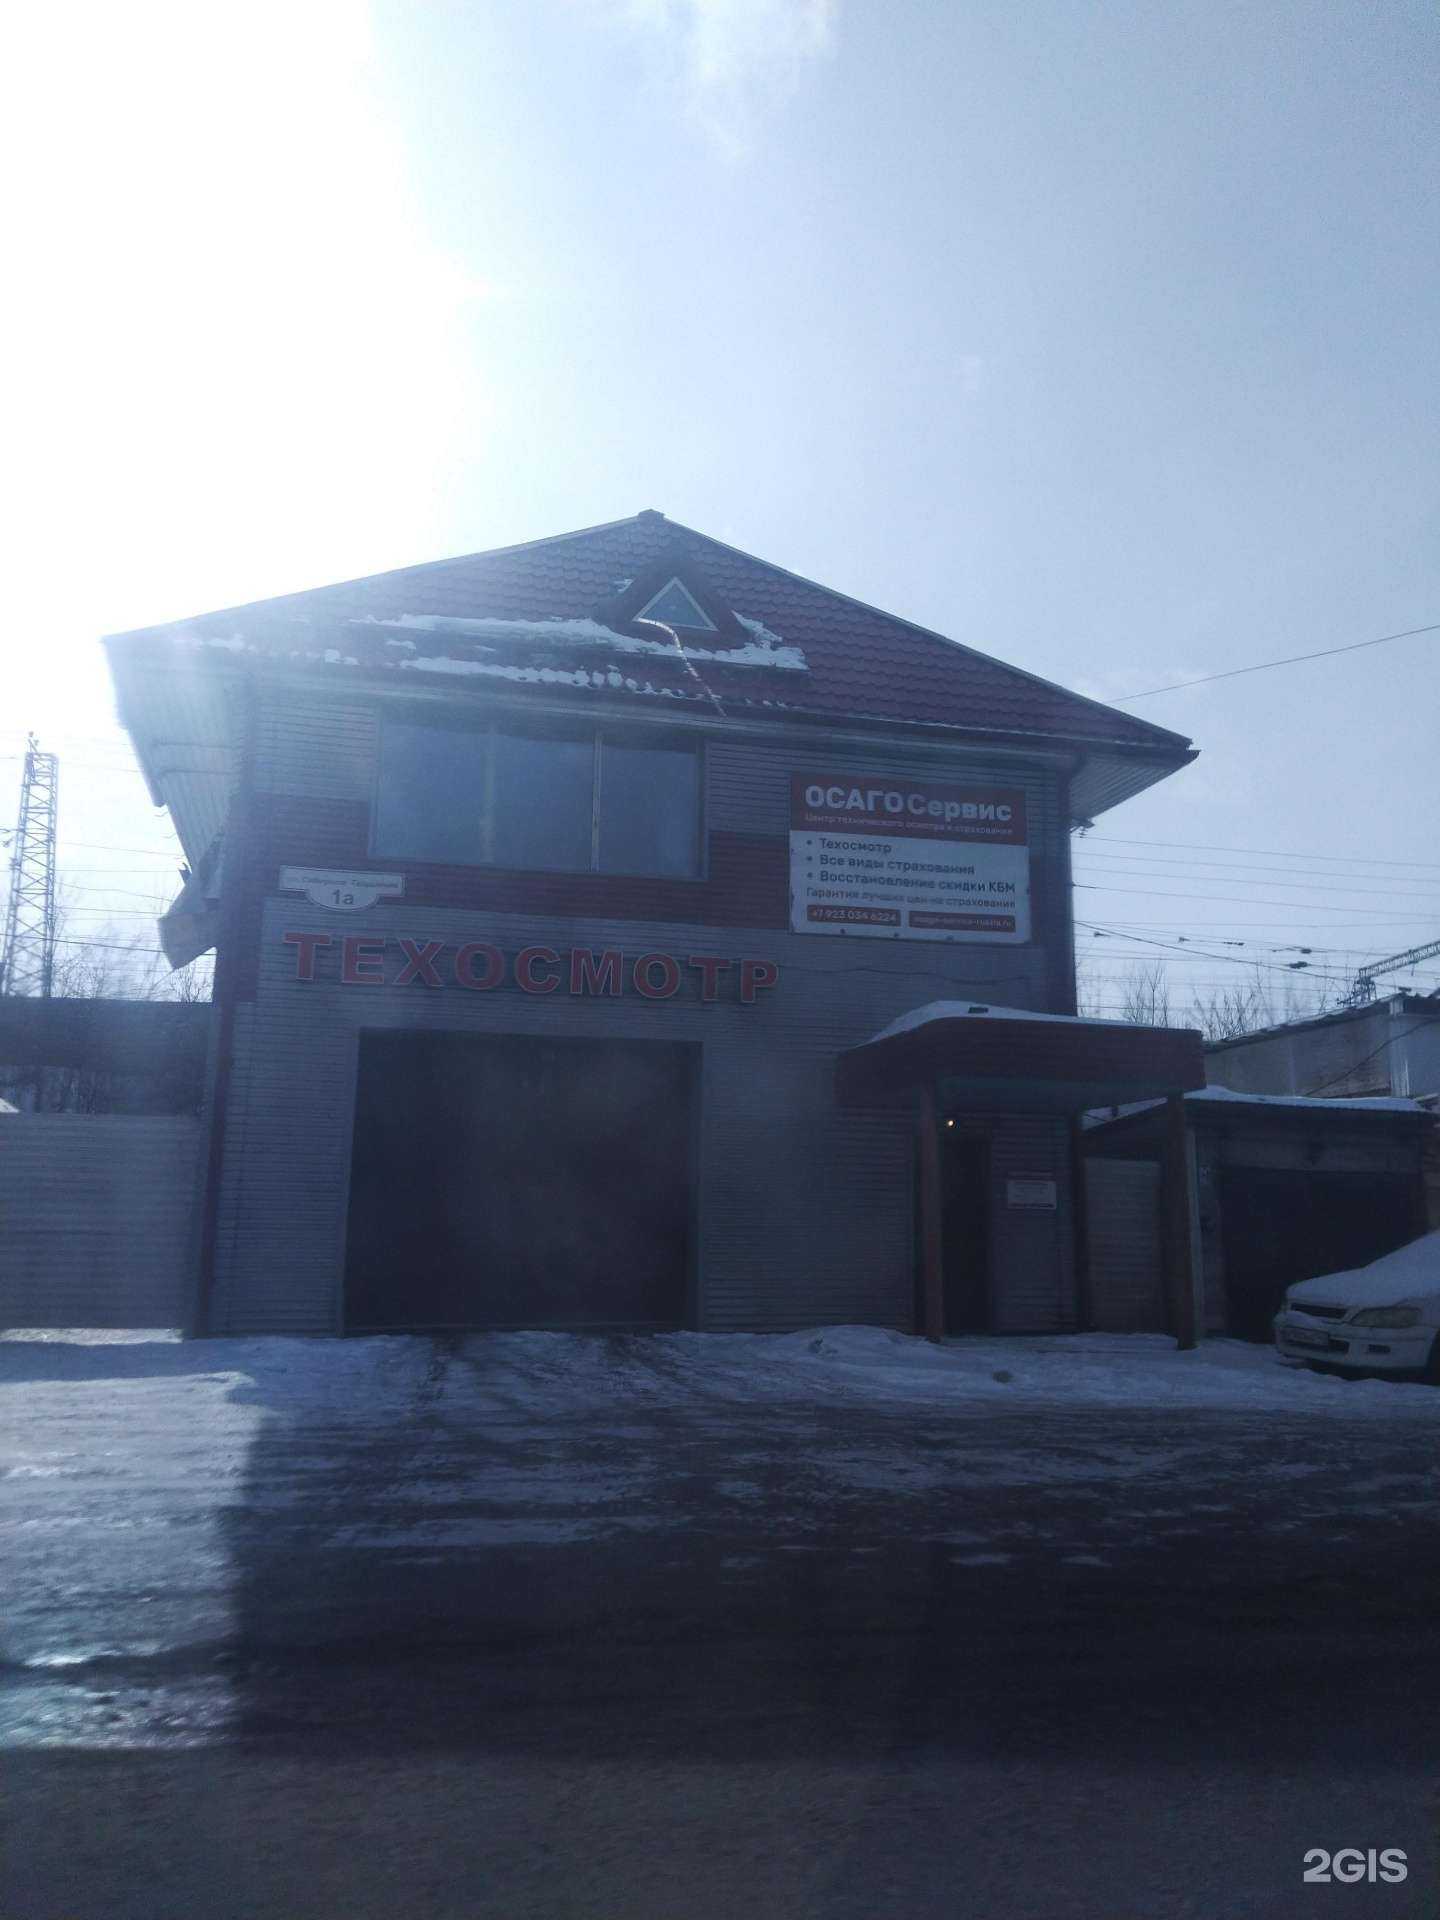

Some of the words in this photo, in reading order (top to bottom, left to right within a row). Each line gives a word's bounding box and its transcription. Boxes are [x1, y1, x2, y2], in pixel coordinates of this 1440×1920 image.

[819, 837, 892, 854] Техосмотр
[819, 854, 847, 866] Все
[848, 857, 884, 869] виды
[887, 861, 975, 876] страхования
[819, 870, 935, 889] Восстановление
[938, 879, 986, 893] скидки
[988, 881, 1016, 894] КБМ
[283, 931, 779, 1003] ТЕХОСМОТР
